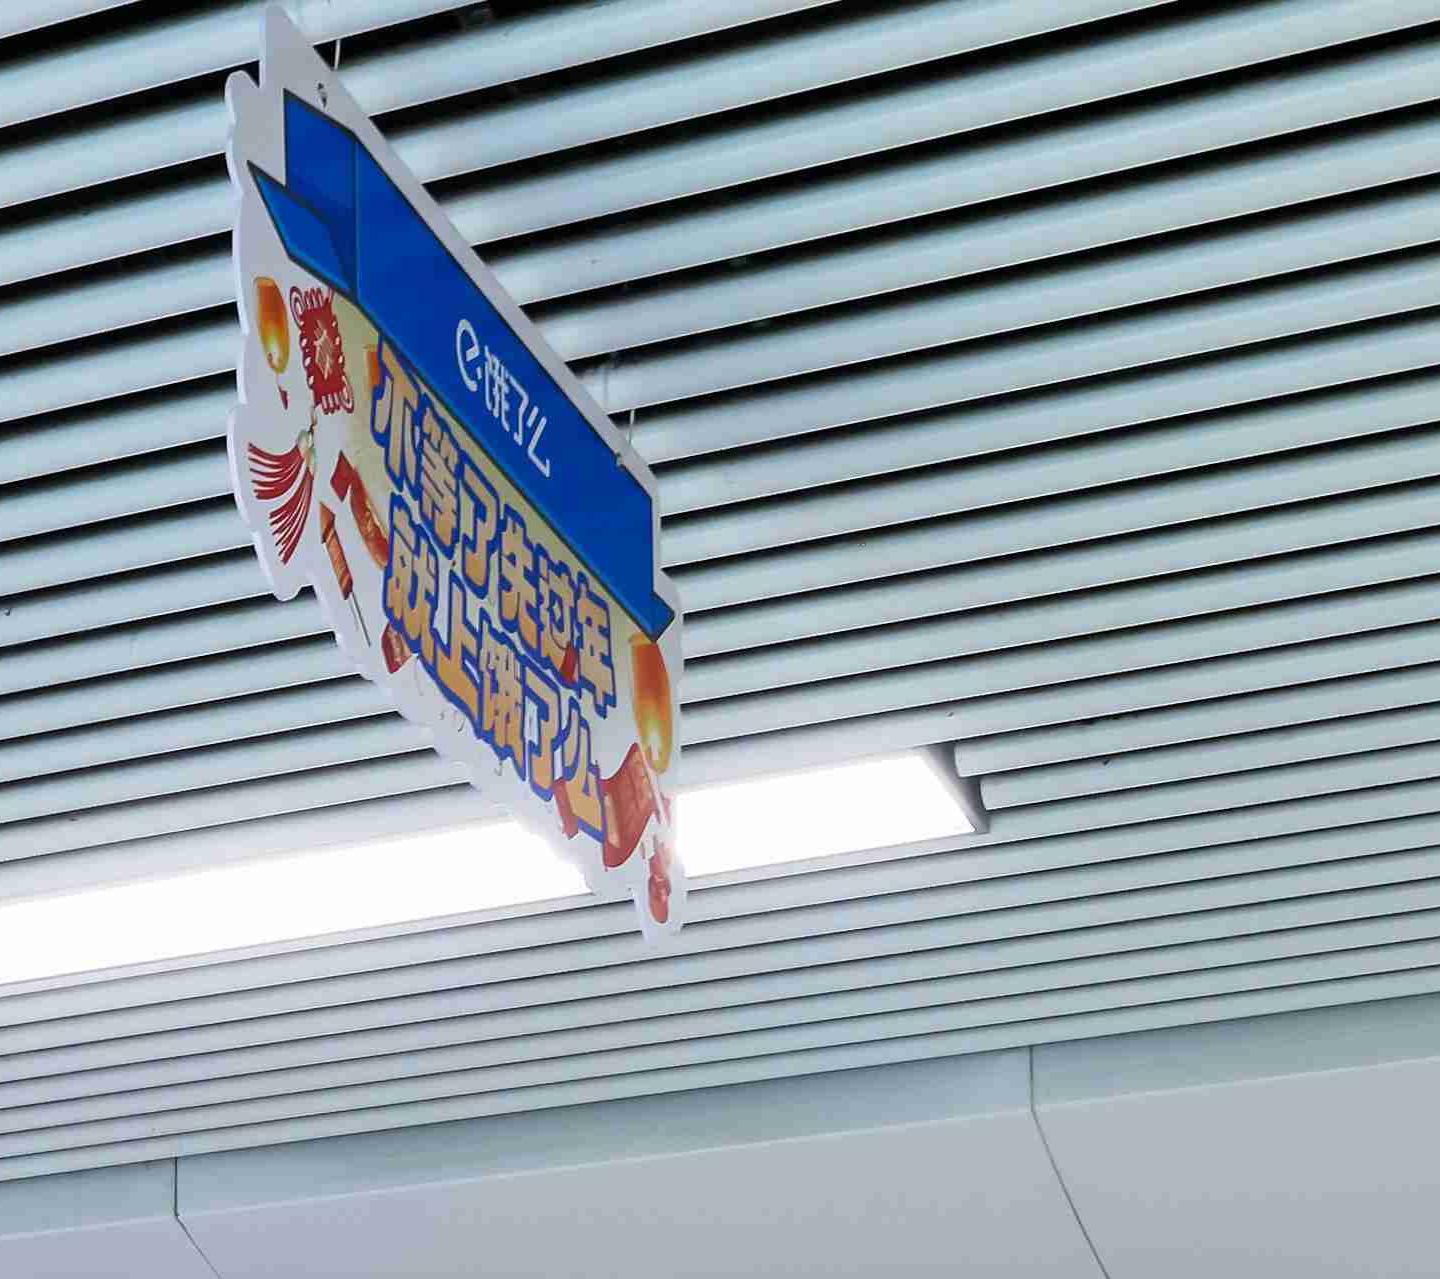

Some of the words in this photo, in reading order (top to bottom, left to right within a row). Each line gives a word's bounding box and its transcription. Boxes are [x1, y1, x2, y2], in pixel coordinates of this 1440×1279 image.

[374, 338, 612, 710] 不等了先过年
[386, 497, 606, 840] 就上饿了么
